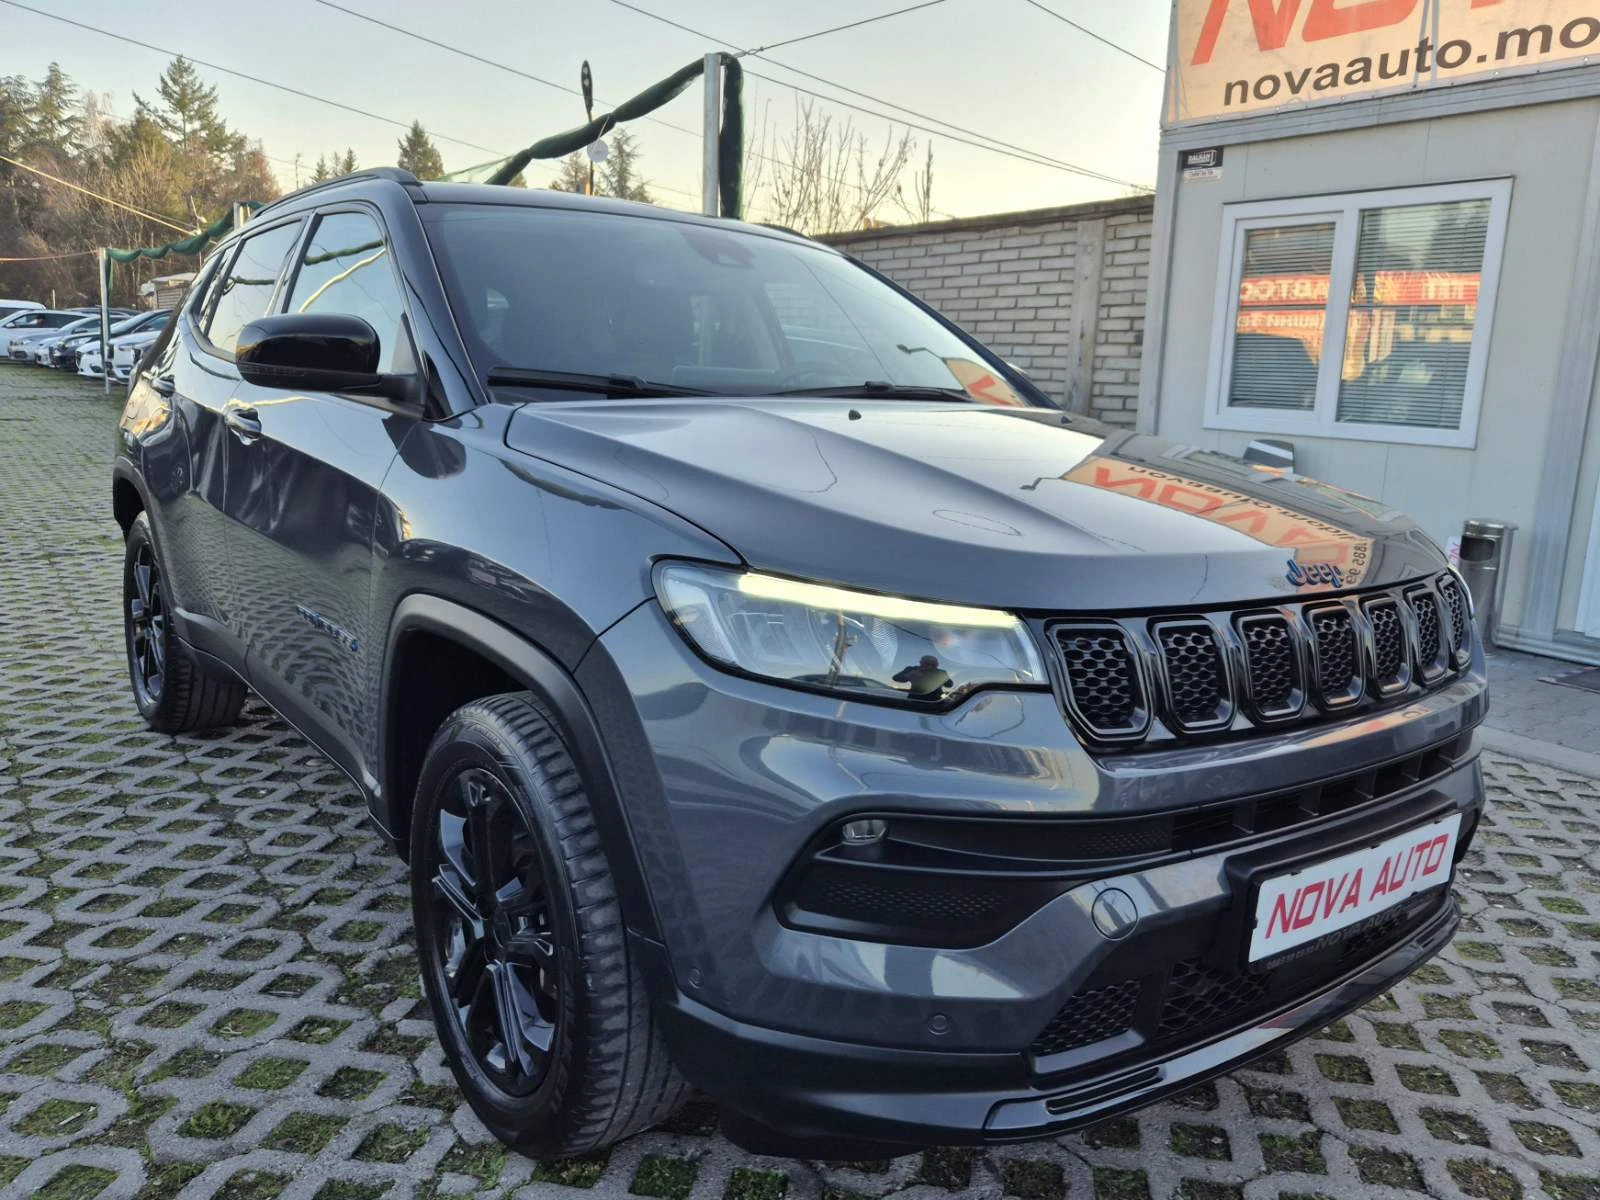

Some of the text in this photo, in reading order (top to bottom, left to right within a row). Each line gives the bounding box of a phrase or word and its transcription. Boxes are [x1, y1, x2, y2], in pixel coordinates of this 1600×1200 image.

[1286, 558, 1344, 588] Jeep
[1265, 833, 1449, 939] NOVA AUTO
